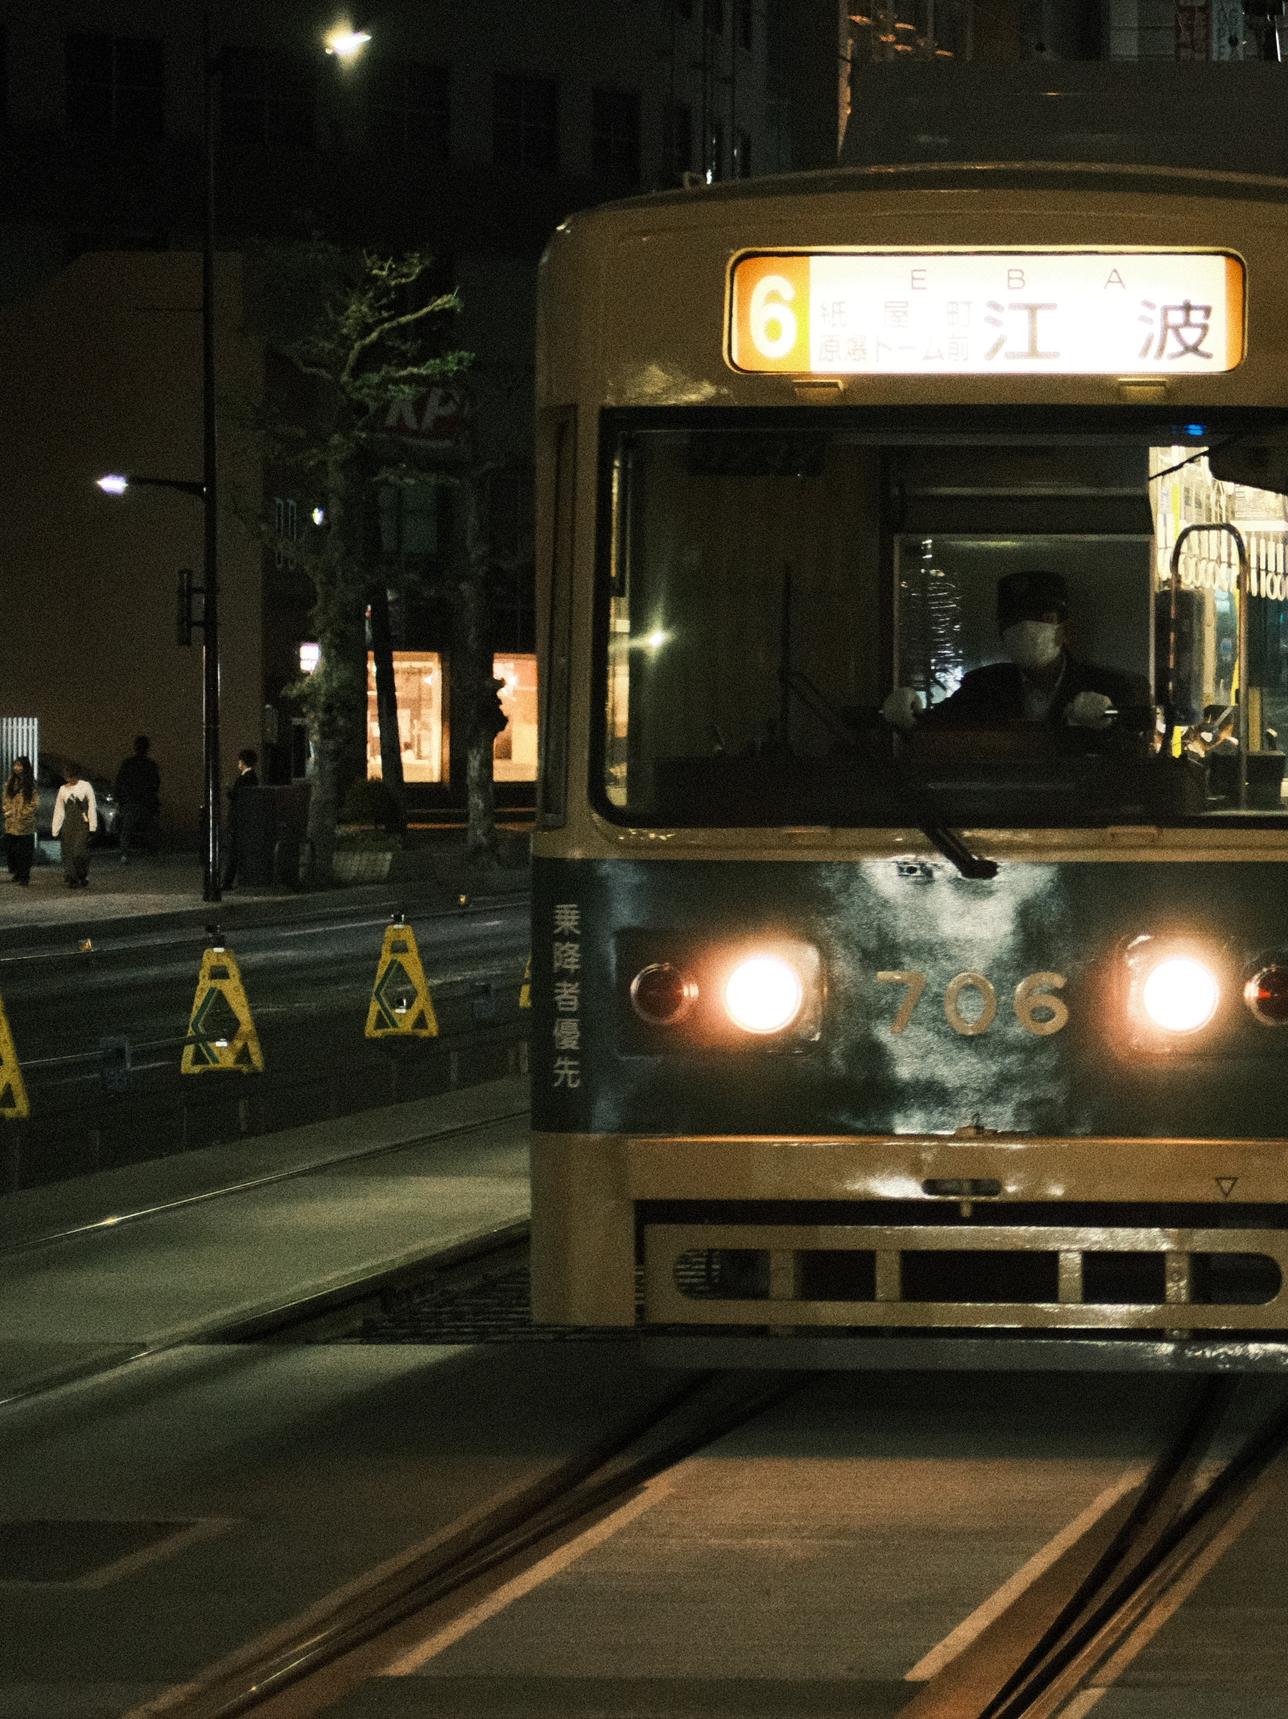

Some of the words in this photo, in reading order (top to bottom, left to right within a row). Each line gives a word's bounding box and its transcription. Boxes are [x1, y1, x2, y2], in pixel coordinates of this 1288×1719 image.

[748, 274, 798, 359] 6
[818, 300, 975, 328] 紙屋町
[983, 298, 1214, 362] 江波
[552, 903, 582, 1089] 乗降者優先
[876, 969, 1071, 1037] 706
